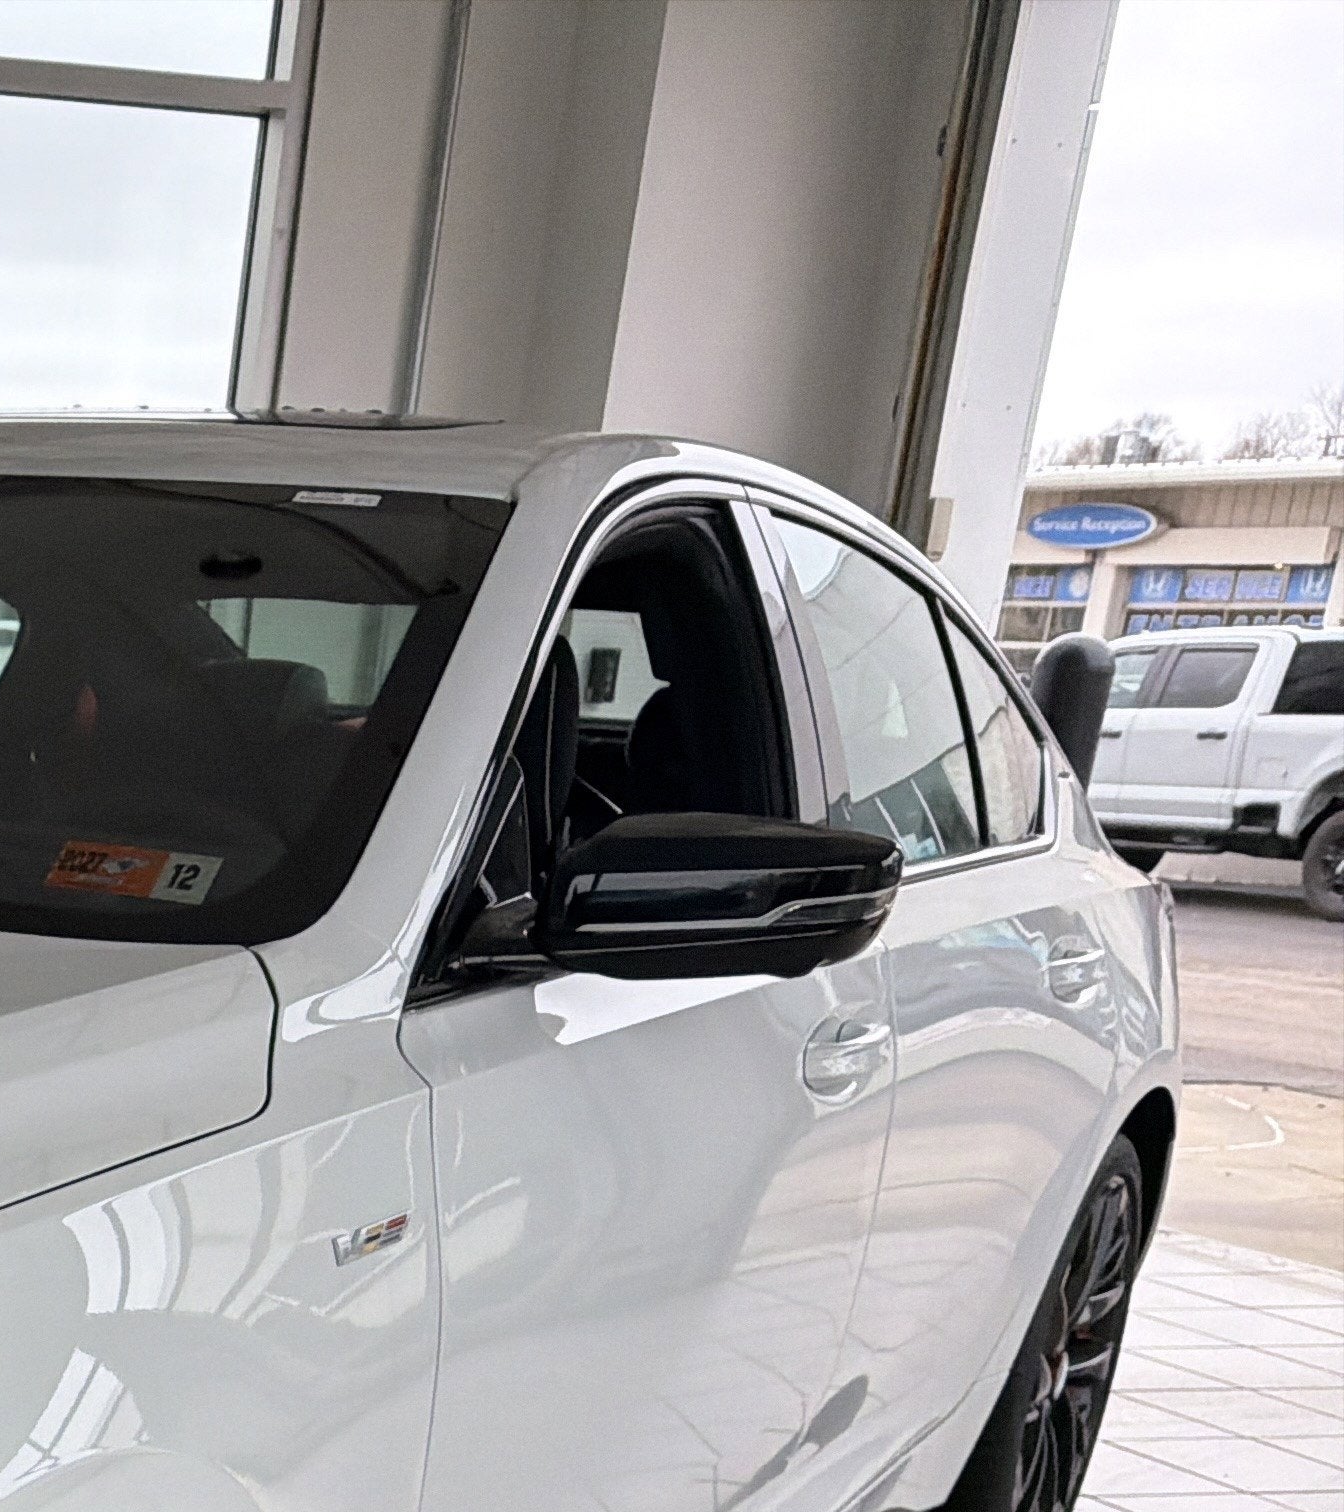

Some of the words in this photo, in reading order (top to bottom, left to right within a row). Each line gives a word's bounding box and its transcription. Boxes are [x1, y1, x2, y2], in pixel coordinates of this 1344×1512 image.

[1033, 516, 1079, 532] Service
[1081, 516, 1147, 534] Reception
[165, 863, 202, 891] 12
